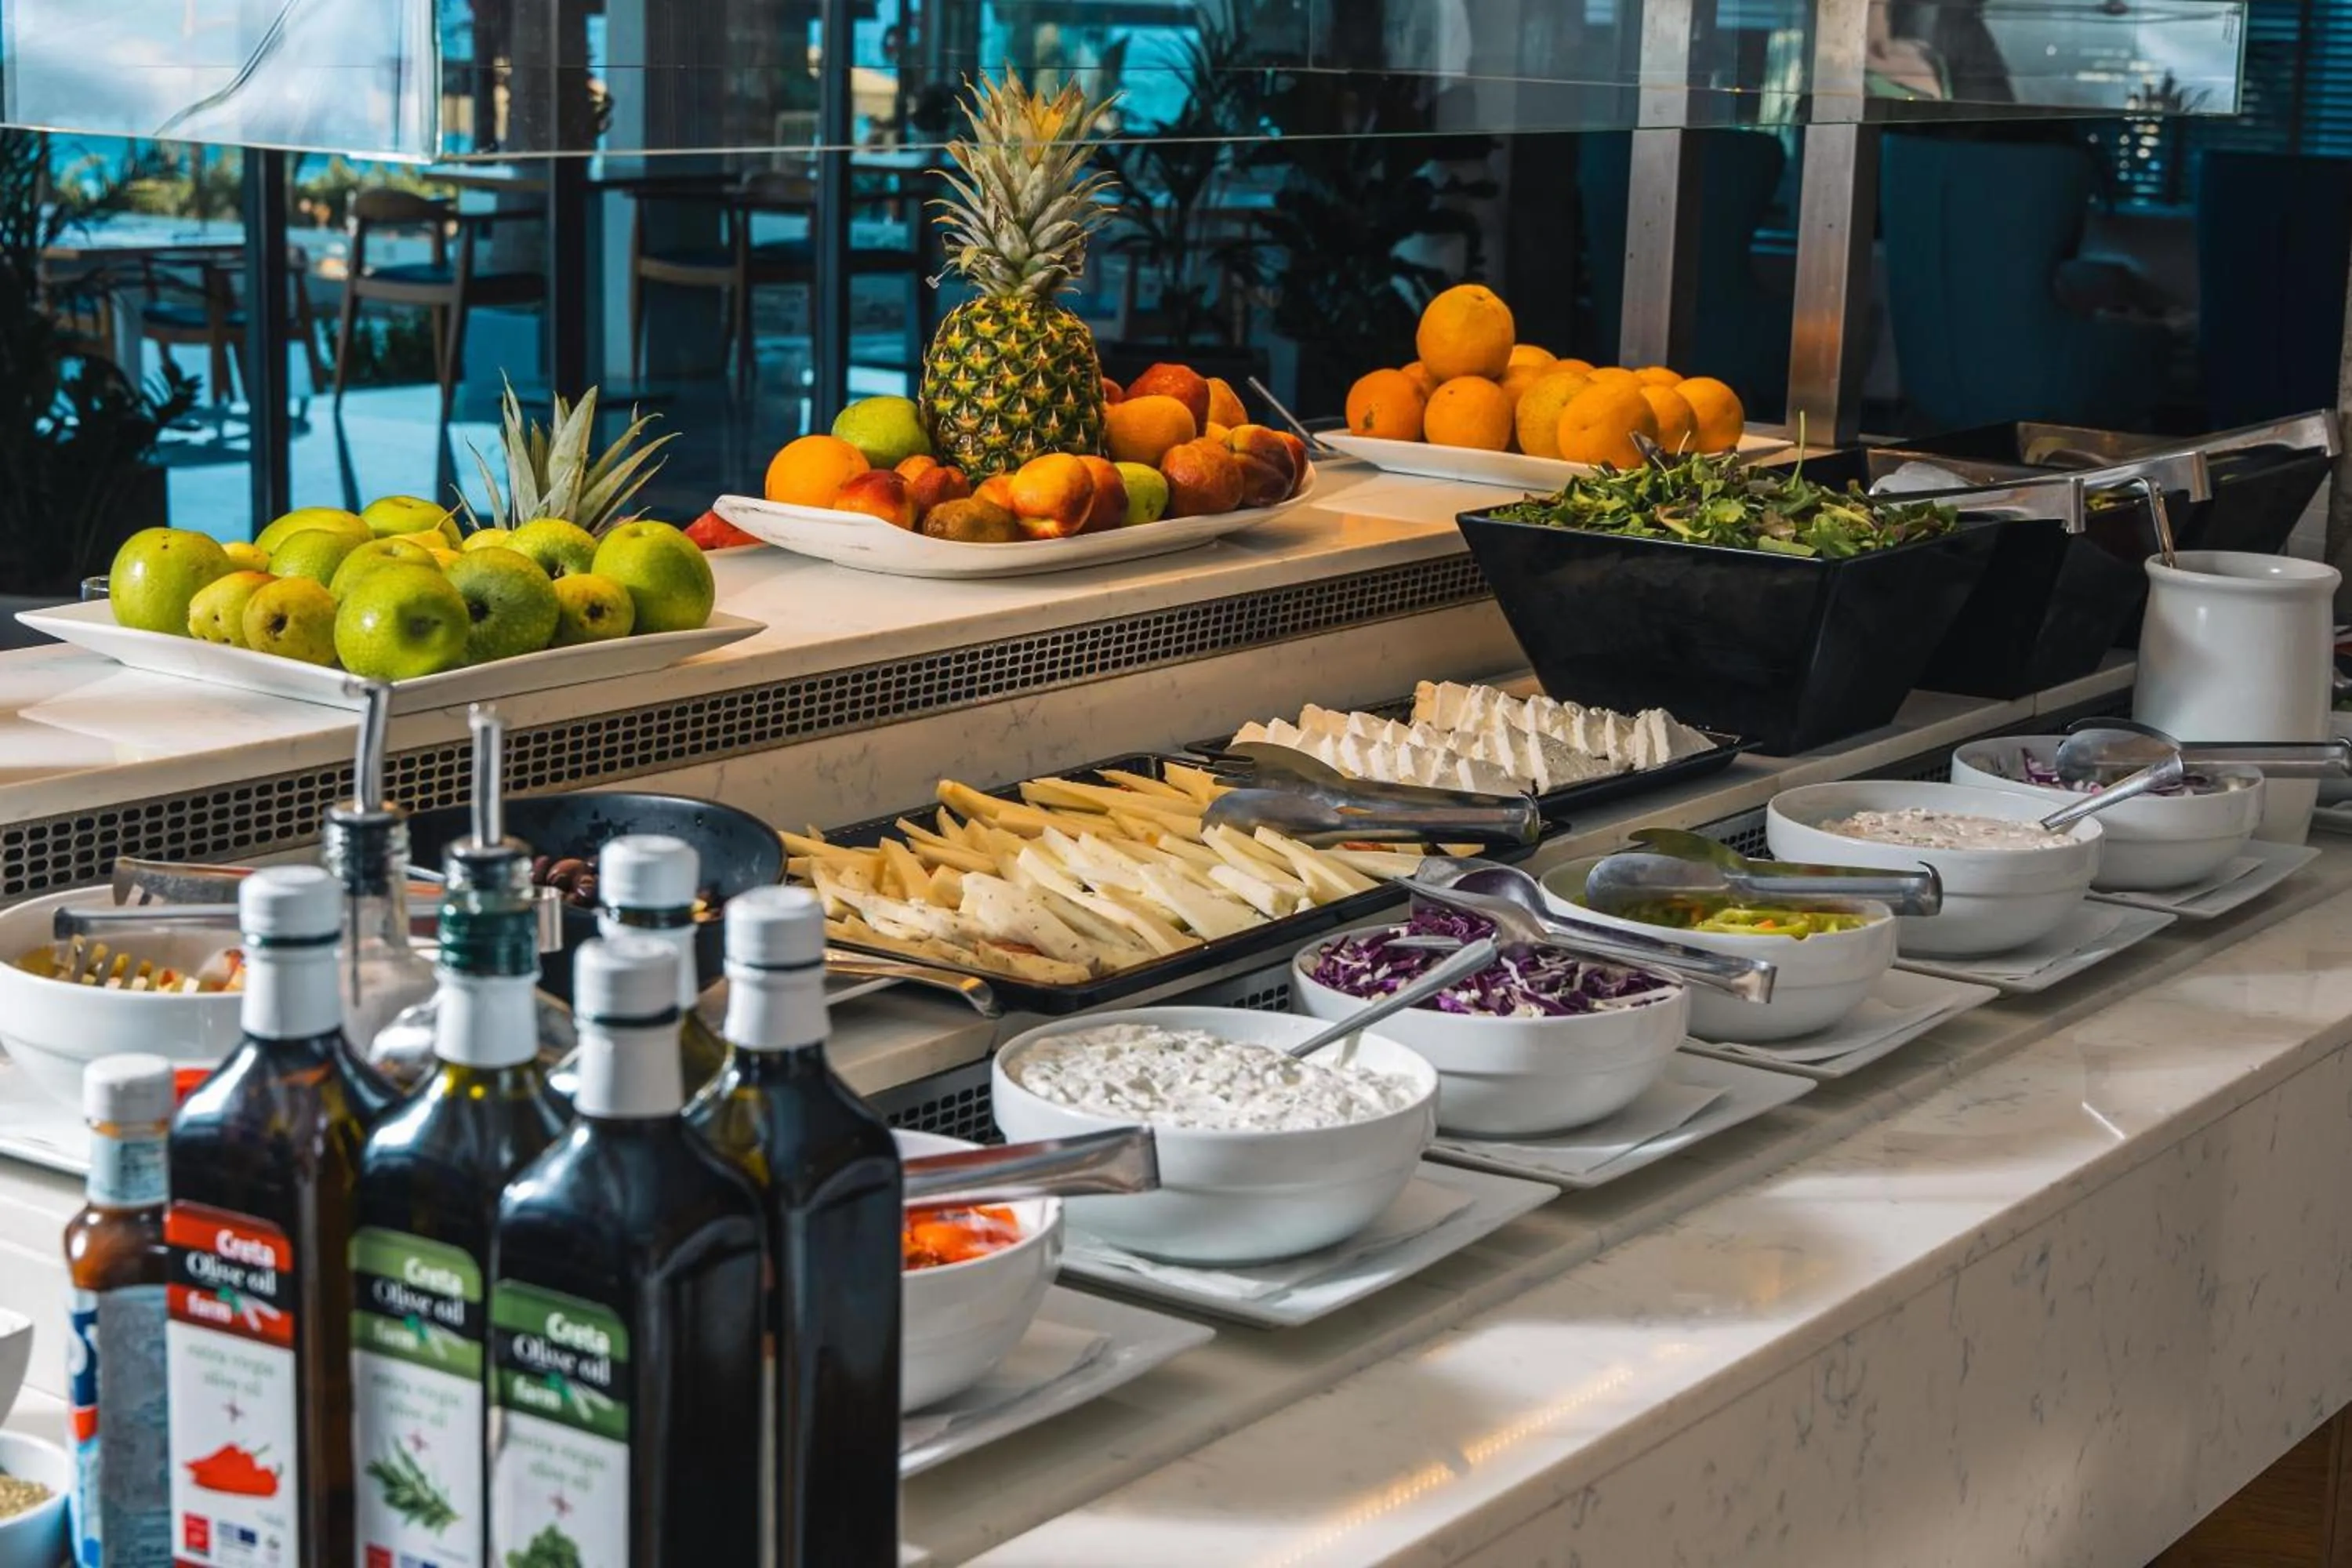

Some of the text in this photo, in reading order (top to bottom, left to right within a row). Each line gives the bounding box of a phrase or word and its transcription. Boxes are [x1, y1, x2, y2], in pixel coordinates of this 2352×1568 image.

[216, 1229, 276, 1268] Creta
[186, 1250, 277, 1296] Olive oil
[404, 1257, 463, 1296] Creta
[187, 1290, 232, 1324] farm
[372, 1278, 465, 1326] Olive oil
[373, 1319, 419, 1352] farm
[546, 1312, 611, 1356] Creta
[513, 1334, 612, 1387] Olive oil
[513, 1375, 562, 1411] farm
